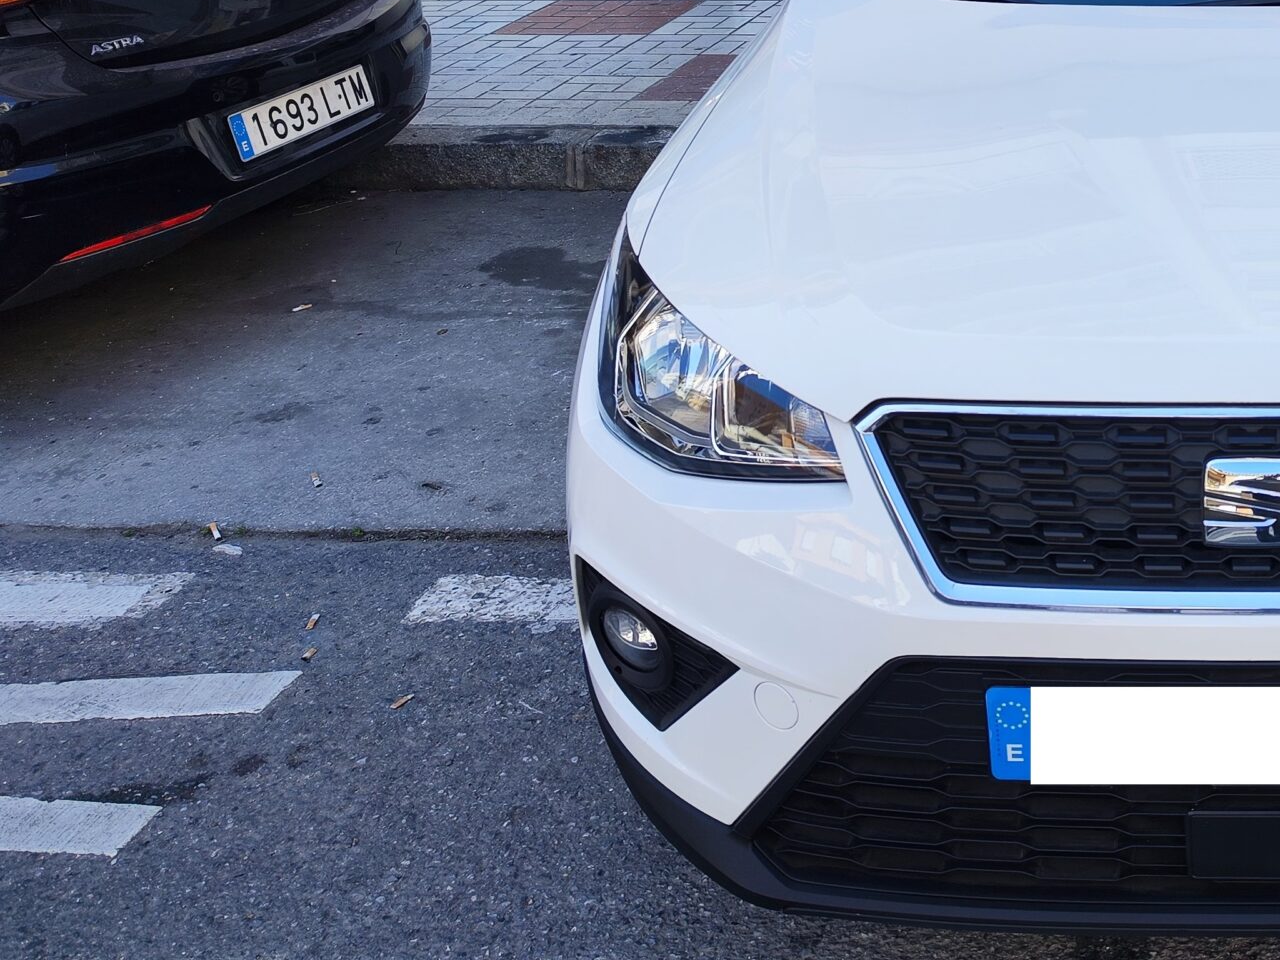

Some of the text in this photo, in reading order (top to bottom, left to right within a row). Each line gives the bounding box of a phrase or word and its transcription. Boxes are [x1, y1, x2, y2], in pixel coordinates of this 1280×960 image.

[90, 35, 145, 56] ASTRA
[252, 71, 369, 146] 1693 LTM
[241, 140, 250, 152] E
[1006, 743, 1025, 762] E
